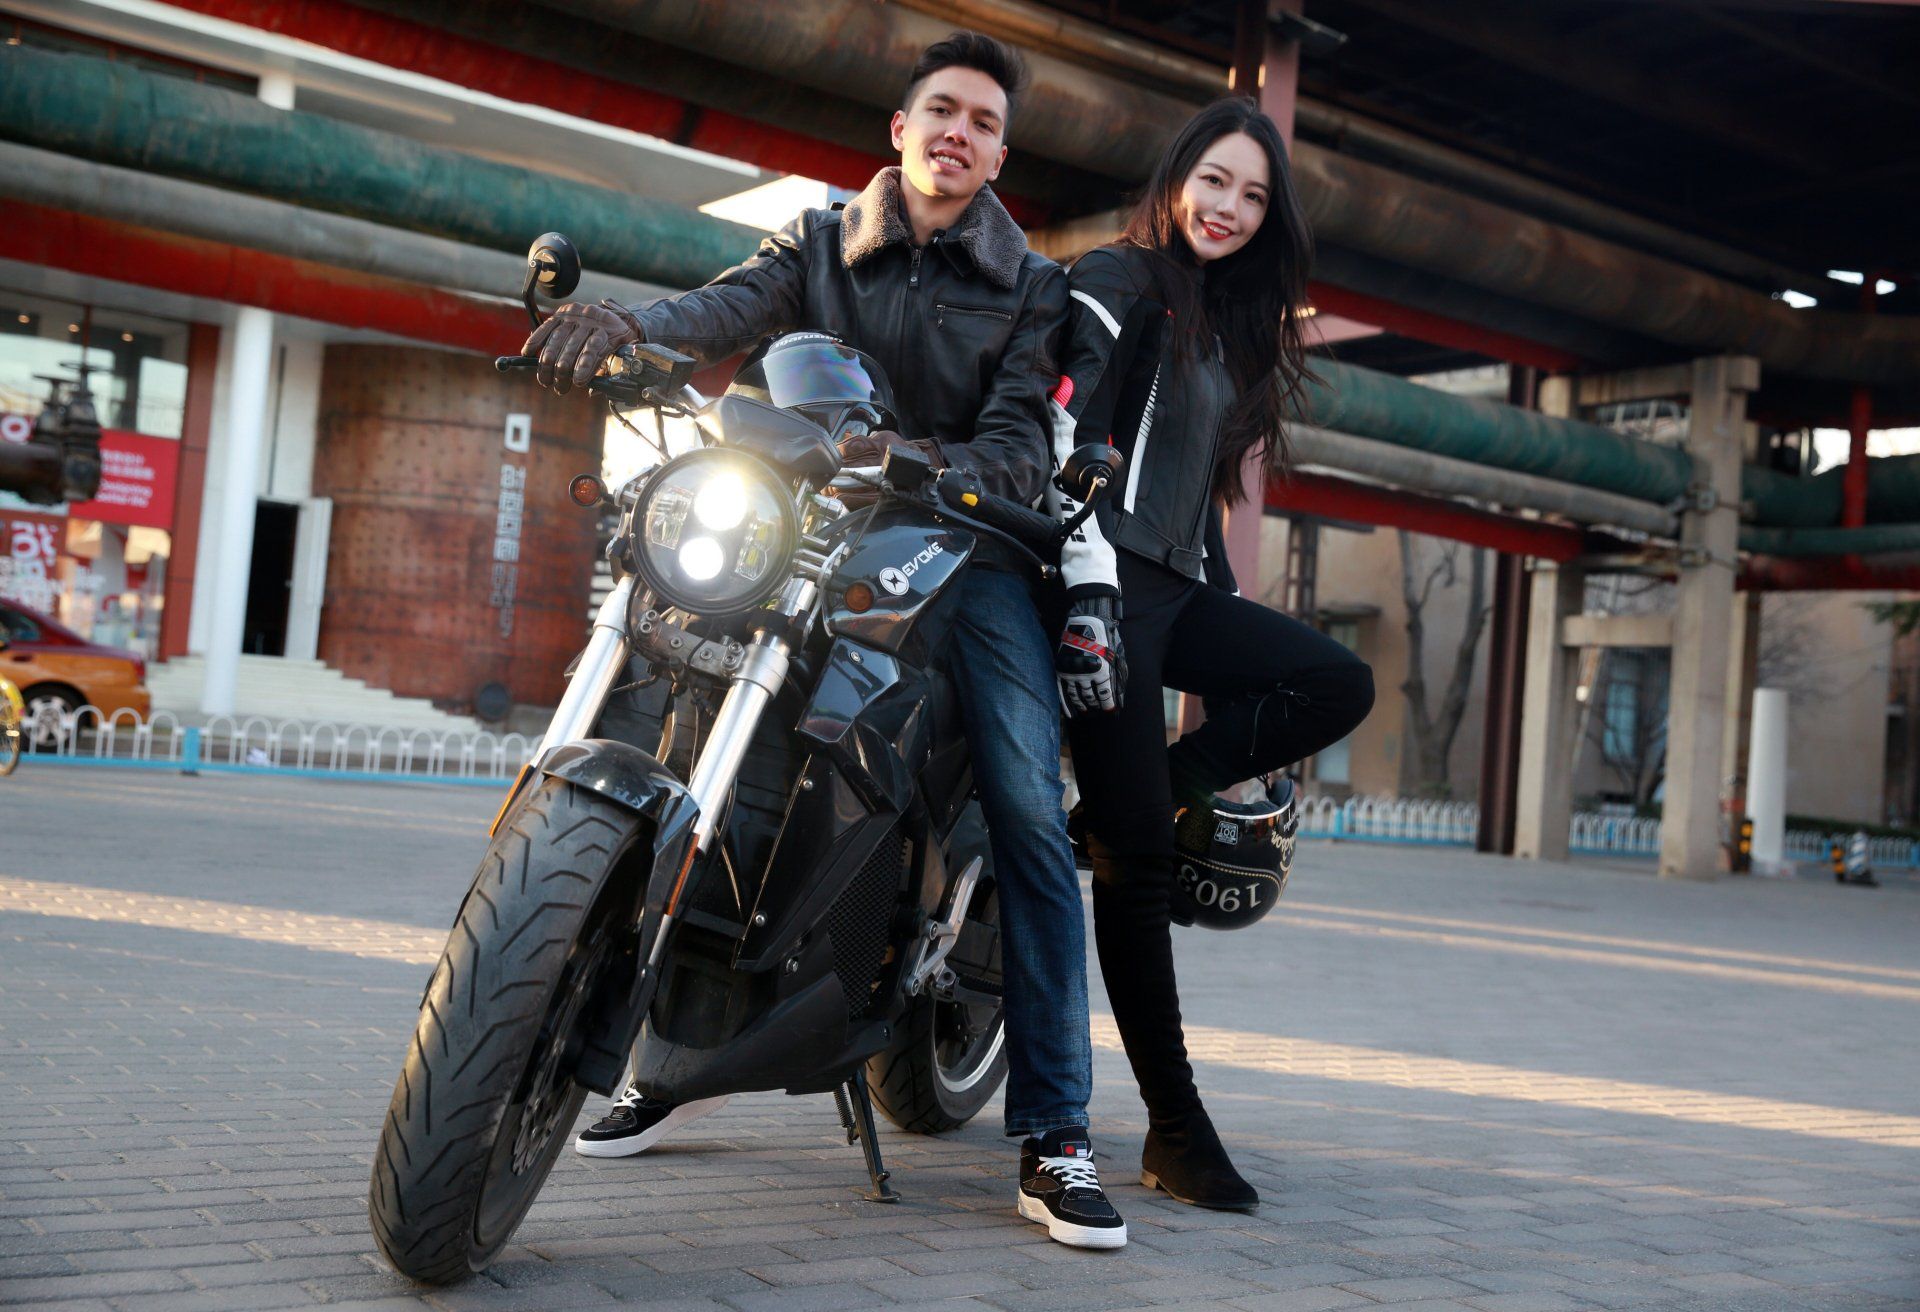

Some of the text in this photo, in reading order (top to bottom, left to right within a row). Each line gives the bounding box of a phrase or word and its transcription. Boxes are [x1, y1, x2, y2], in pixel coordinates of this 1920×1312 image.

[902, 541, 944, 577] EVOKE
[1219, 828, 1236, 838] DOT
[1177, 865, 1261, 912] 1903
